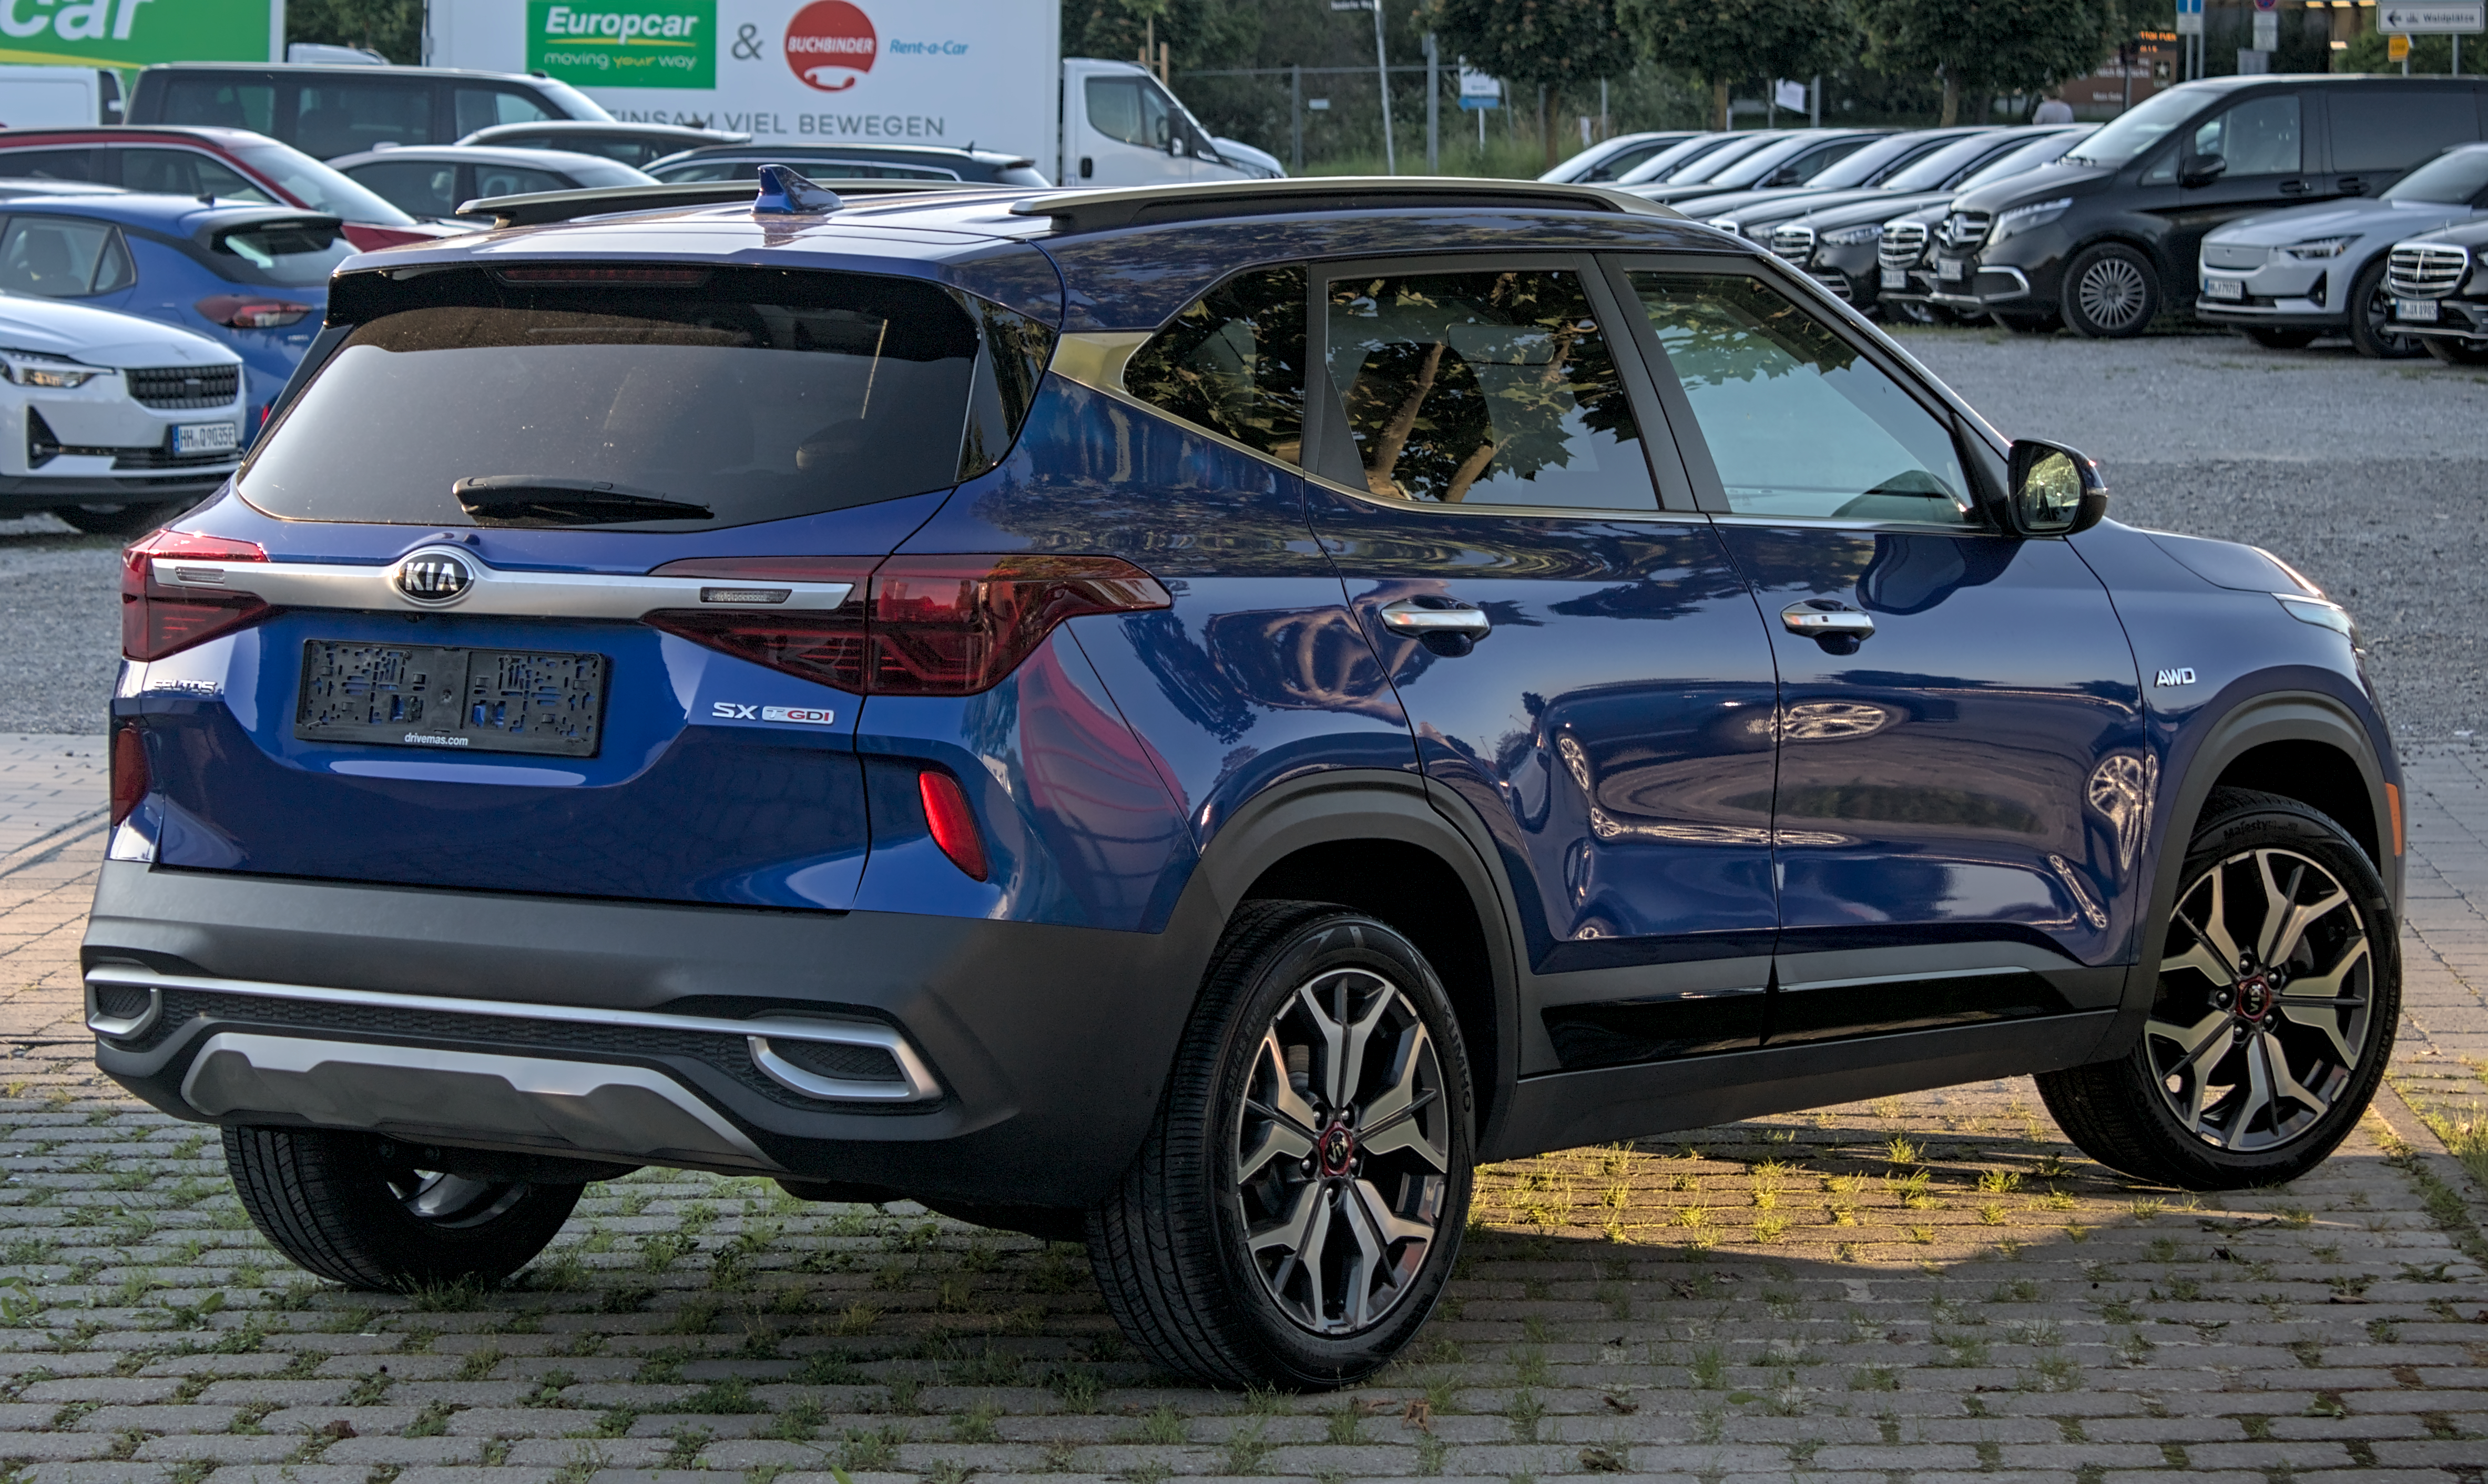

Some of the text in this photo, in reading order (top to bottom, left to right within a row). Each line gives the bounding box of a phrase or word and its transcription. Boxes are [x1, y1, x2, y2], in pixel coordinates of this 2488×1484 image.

[545, 6, 699, 45] Europcar
[2423, 13, 2474, 23] Waldplätze
[731, 24, 764, 60] &
[788, 36, 875, 54] BUCHBINDER
[890, 39, 969, 55] Rent-a-Car
[544, 52, 697, 71] moving your way
[724, 112, 787, 134] VIEL
[799, 114, 944, 137] BEWEGEN
[180, 429, 193, 448] HH
[405, 562, 458, 591] KIA
[151, 679, 219, 694] SELTOS
[2154, 667, 2196, 687] AWD
[712, 702, 758, 720] SX
[404, 732, 468, 746] drivemas.com
[1442, 1004, 1471, 1112] KUMHO
